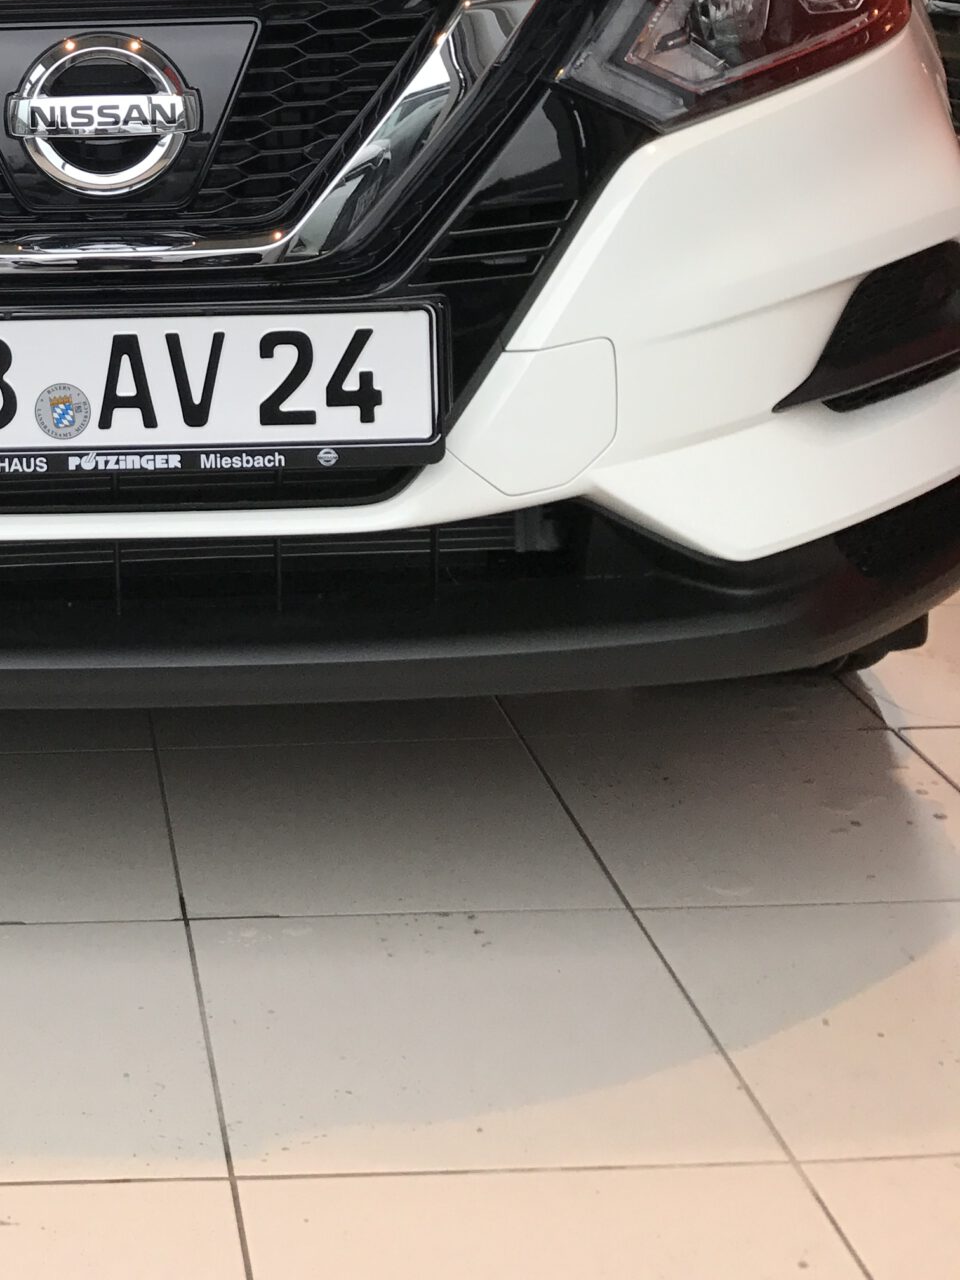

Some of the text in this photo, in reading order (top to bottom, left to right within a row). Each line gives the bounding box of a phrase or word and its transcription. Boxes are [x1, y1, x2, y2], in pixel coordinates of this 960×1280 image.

[29, 104, 177, 129] NISSAN
[98, 331, 226, 430] AV
[259, 328, 383, 424] 24
[200, 451, 286, 469] Miesbach
